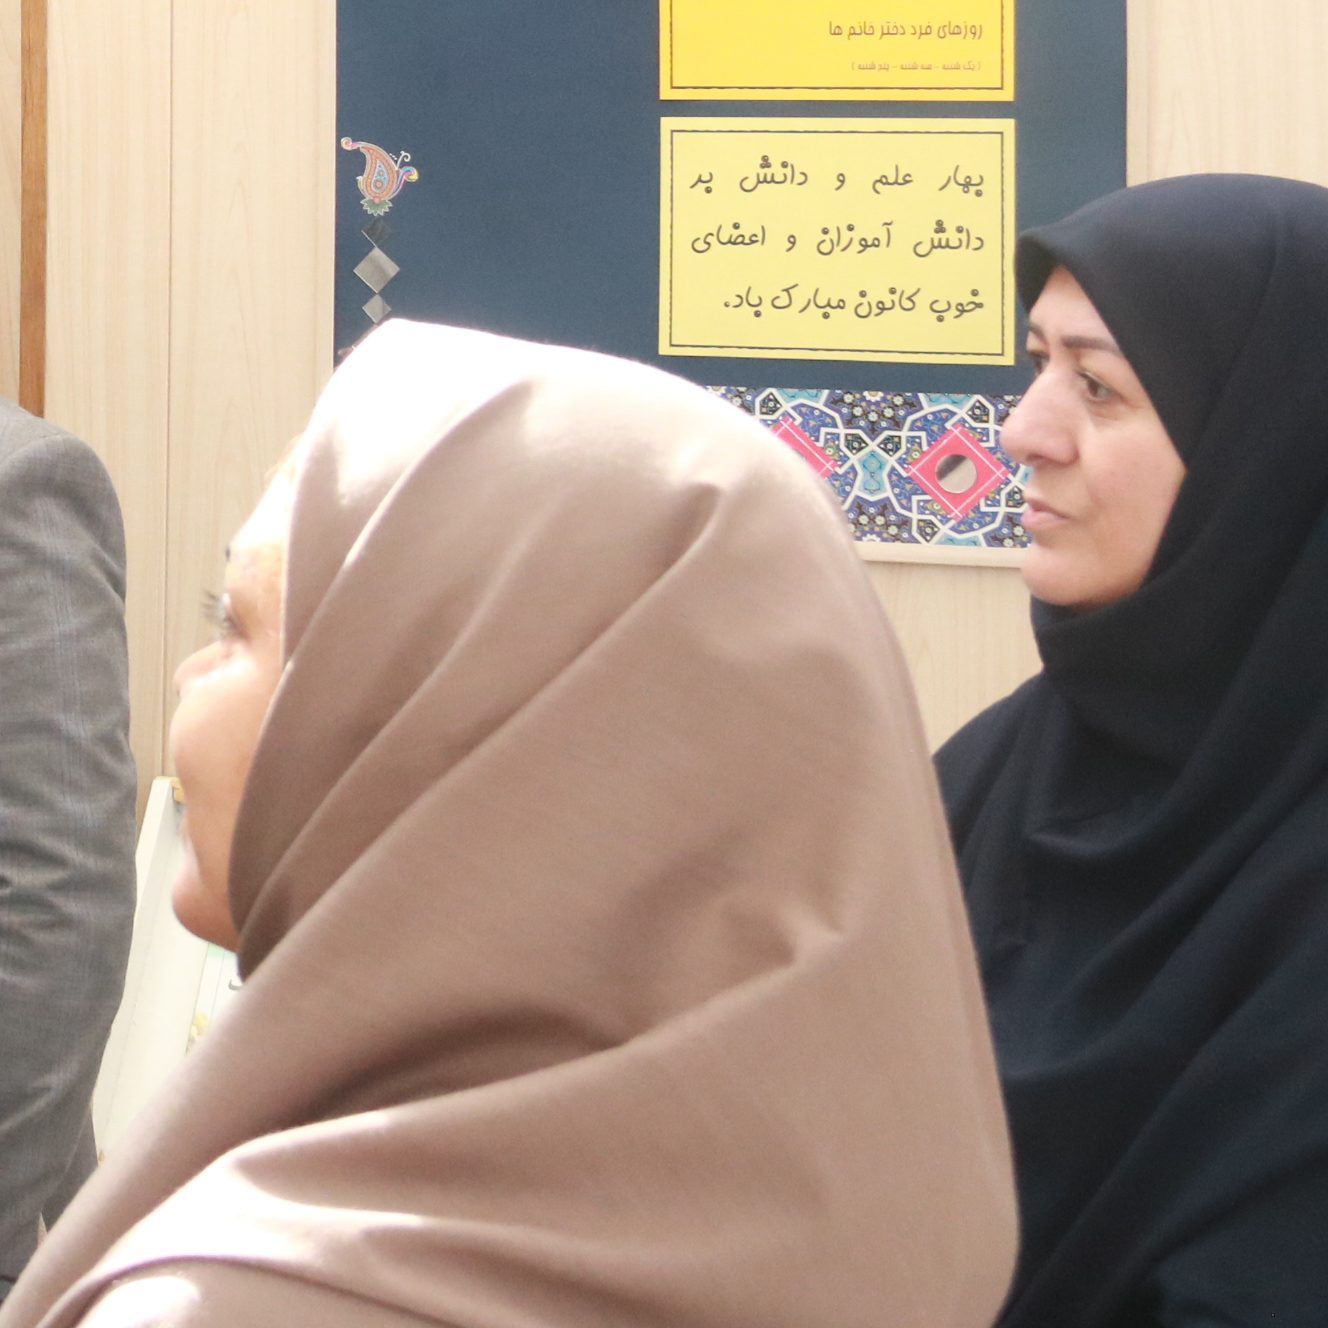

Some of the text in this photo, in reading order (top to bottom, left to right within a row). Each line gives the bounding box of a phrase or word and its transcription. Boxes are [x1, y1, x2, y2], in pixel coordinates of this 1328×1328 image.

[829, 21, 843, 36] ها
[848, 21, 875, 40] خانم
[879, 22, 906, 40] دختر
[910, 21, 932, 40] فرد
[689, 155, 984, 197] بهار علم و دانش بر
[691, 220, 984, 257] دانش آموزان و اعضای
[724, 283, 984, 322] خوب کانون مبارک باد.
